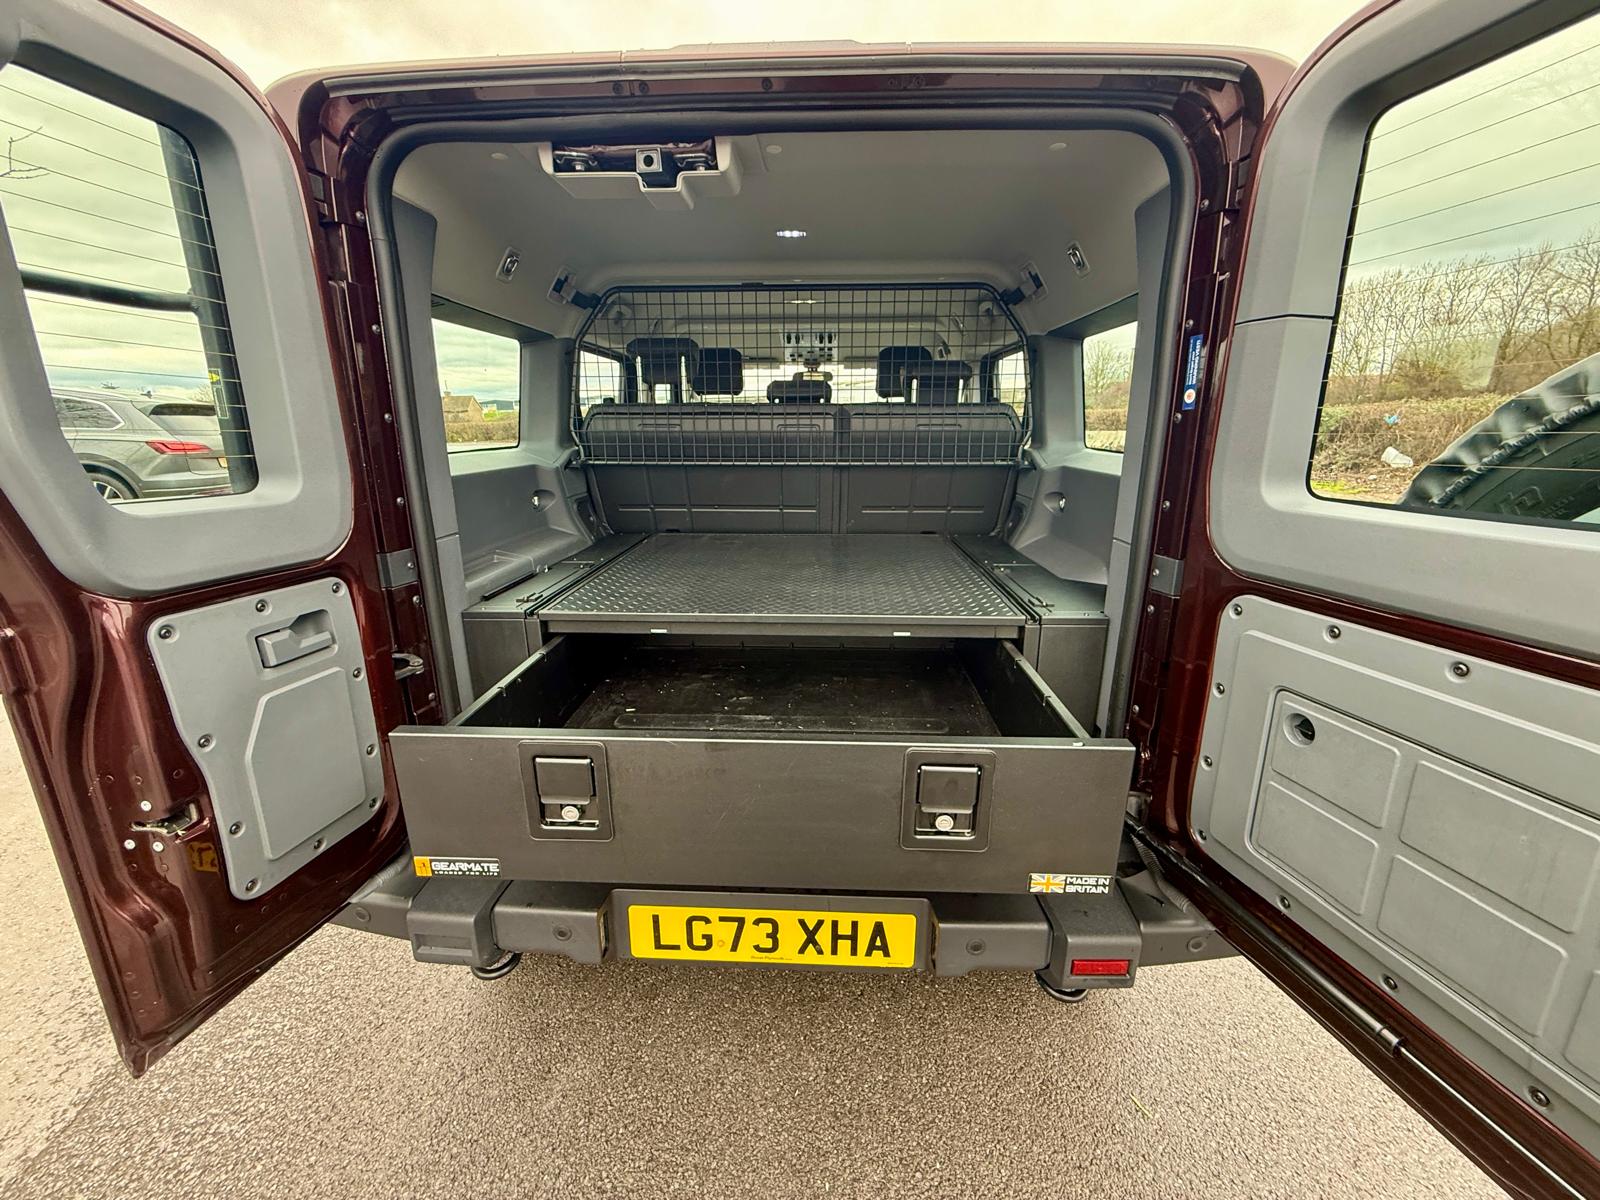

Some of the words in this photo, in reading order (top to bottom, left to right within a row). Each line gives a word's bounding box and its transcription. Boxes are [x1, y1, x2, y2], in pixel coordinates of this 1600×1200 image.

[431, 861, 500, 872] GEARMATE
[1066, 877, 1097, 885] MADE
[1065, 885, 1109, 893] BRITAIN
[652, 914, 780, 954] LG73
[797, 918, 891, 958] XHA
